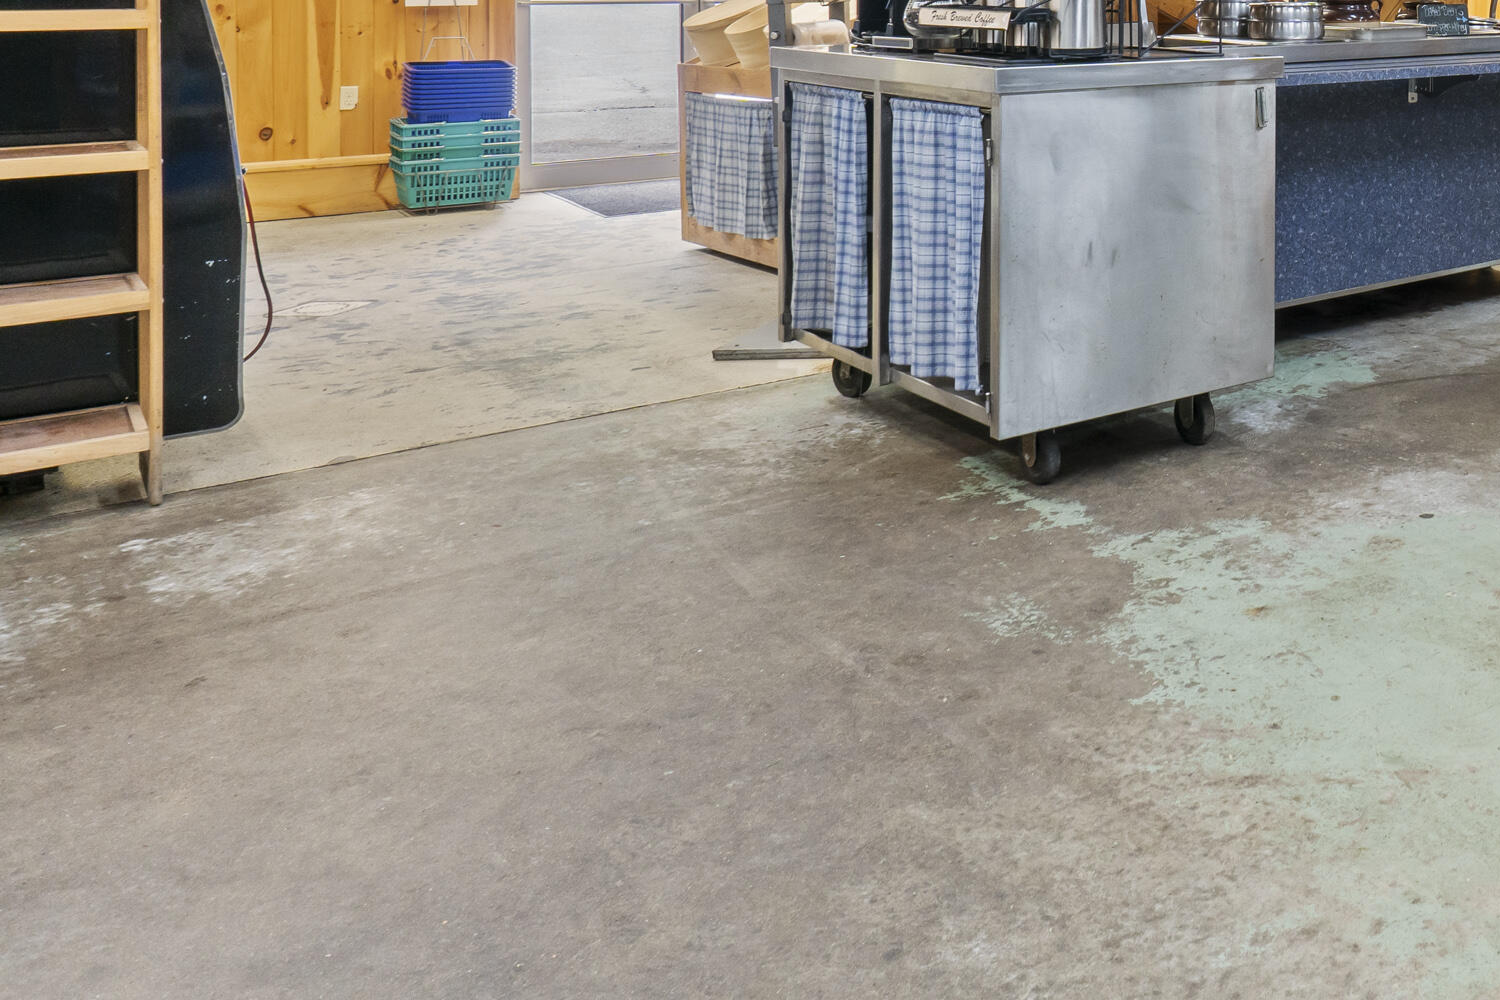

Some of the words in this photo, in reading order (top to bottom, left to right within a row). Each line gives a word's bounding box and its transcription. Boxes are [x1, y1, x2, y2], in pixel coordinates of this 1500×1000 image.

[931, 10, 948, 22] Fresh
[950, 10, 972, 22] Brewed
[974, 11, 996, 26] Coffee
